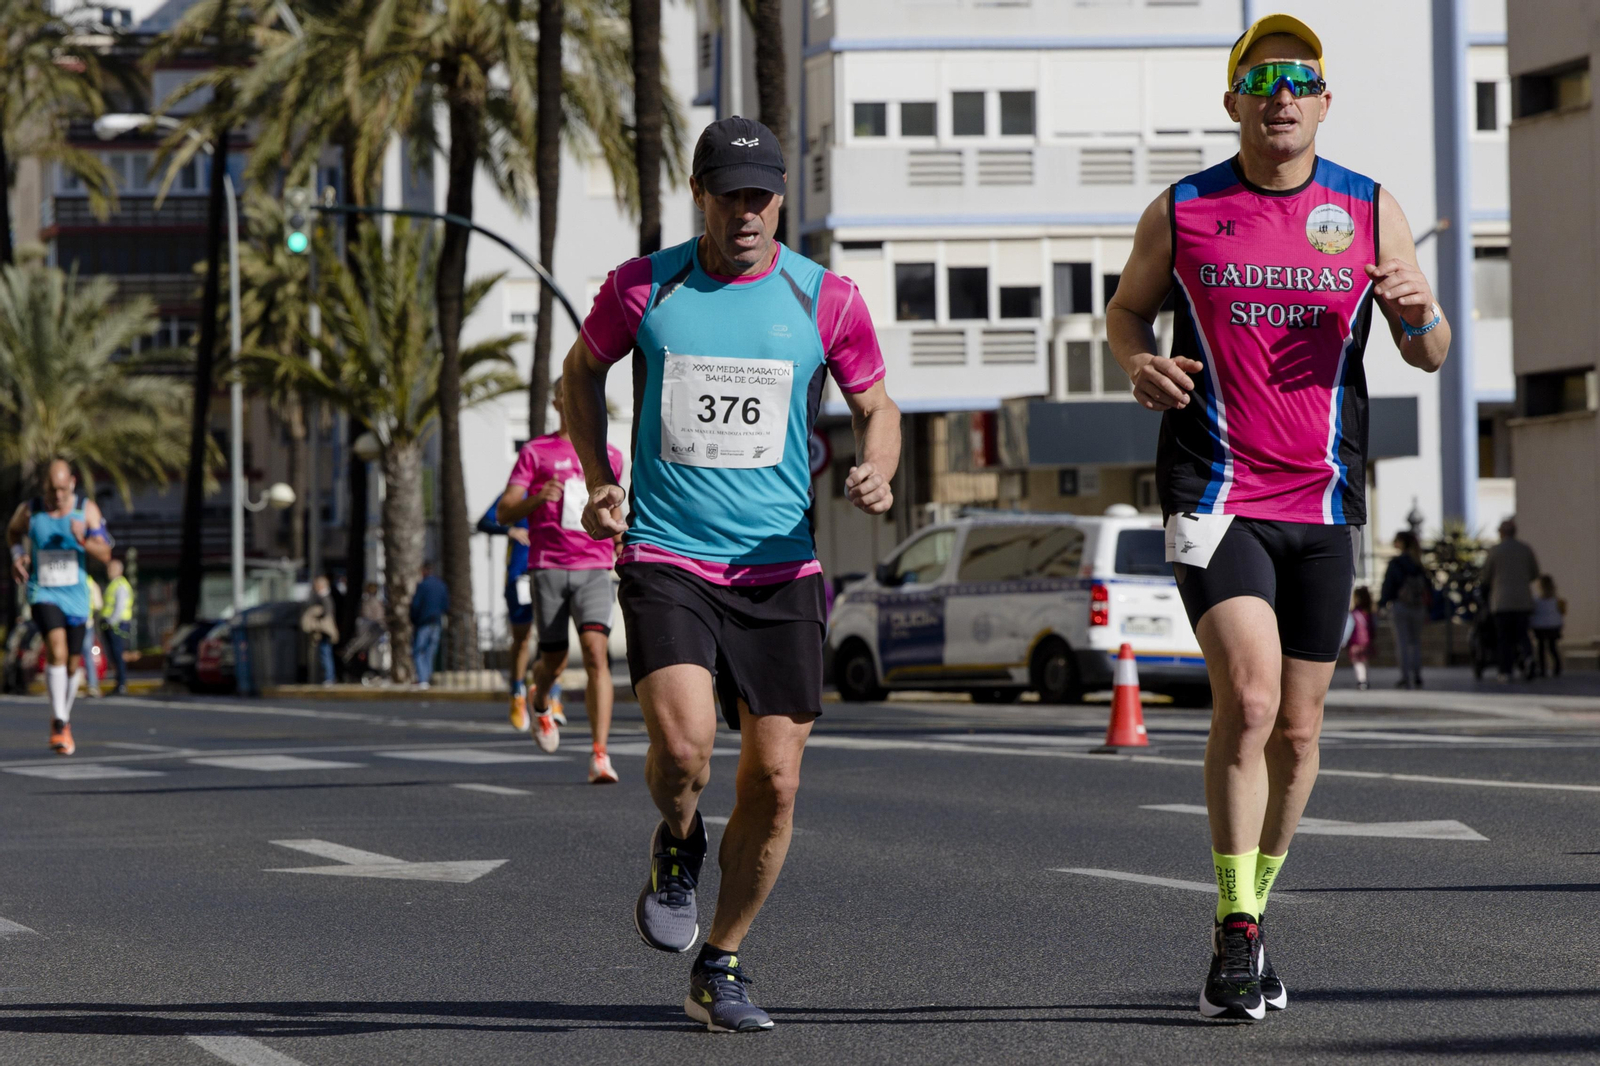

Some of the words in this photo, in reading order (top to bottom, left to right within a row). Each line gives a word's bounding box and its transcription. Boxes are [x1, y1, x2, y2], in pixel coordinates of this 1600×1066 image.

[1200, 263, 1354, 292] GADEIRAS
[1230, 301, 1327, 327] SPORT
[692, 363, 715, 372] XXXV
[716, 365, 745, 374] MEDIA
[747, 367, 790, 376] MARATÓN
[705, 374, 733, 383] BAHÍA
[734, 376, 747, 384] DE
[748, 376, 777, 385] CÁDIZ
[697, 394, 761, 425] 376
[1225, 868, 1237, 902] CYCLES
